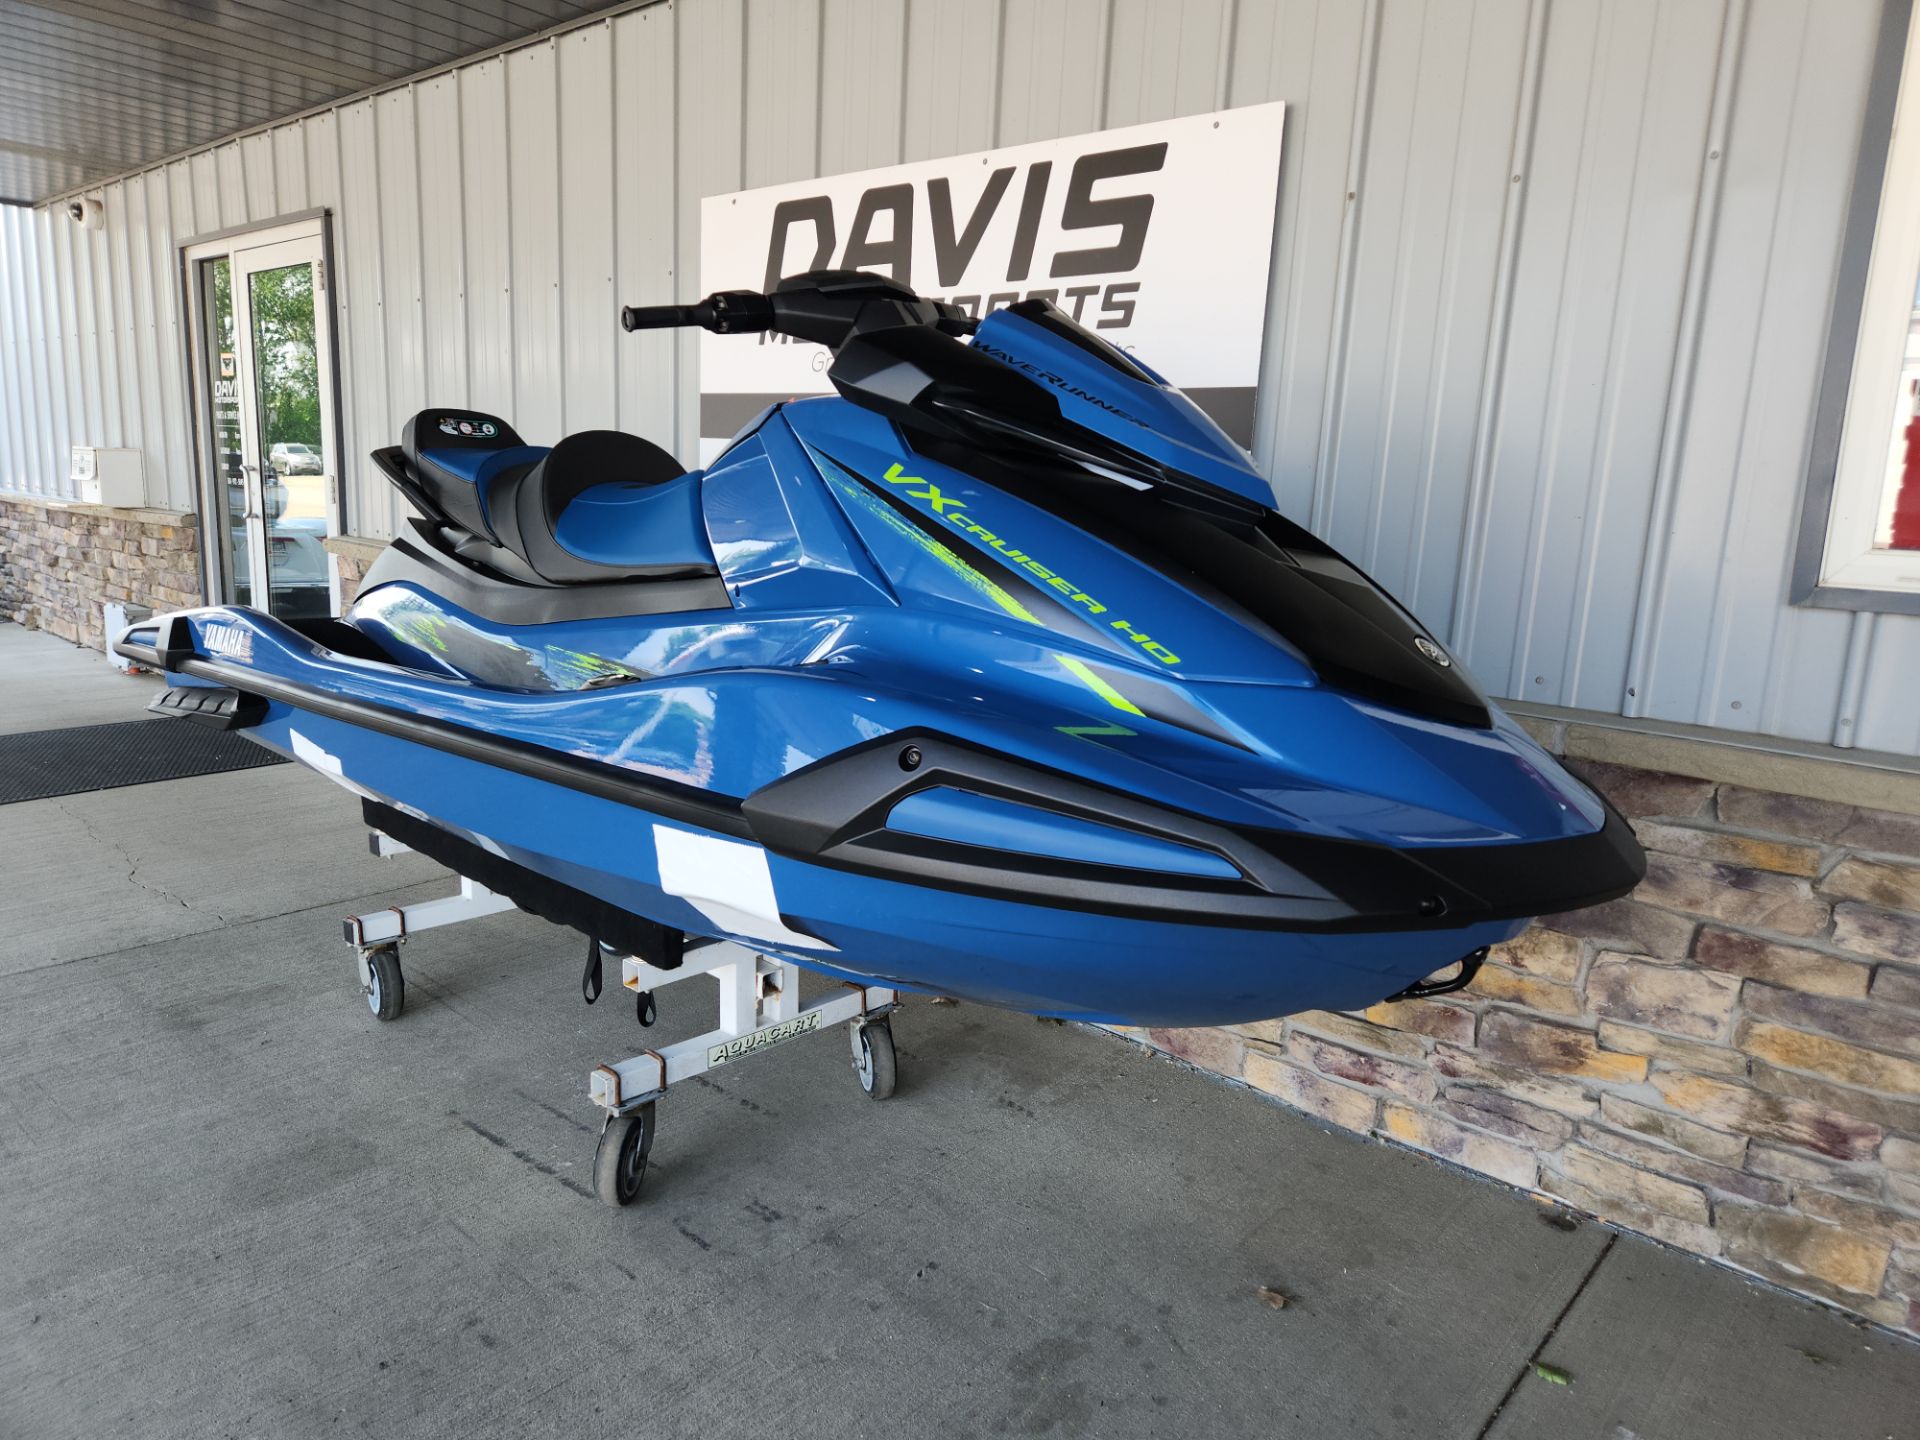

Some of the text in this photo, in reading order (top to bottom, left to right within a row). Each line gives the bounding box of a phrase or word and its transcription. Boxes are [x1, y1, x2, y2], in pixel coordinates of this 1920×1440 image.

[763, 142, 1168, 295] DAVIS
[215, 381, 238, 397] DAVI
[972, 340, 1150, 427] WAVERUNNER
[204, 623, 245, 657] YAMAHA
[1110, 620, 1181, 665] HO
[713, 1013, 818, 1062] AQUACART
